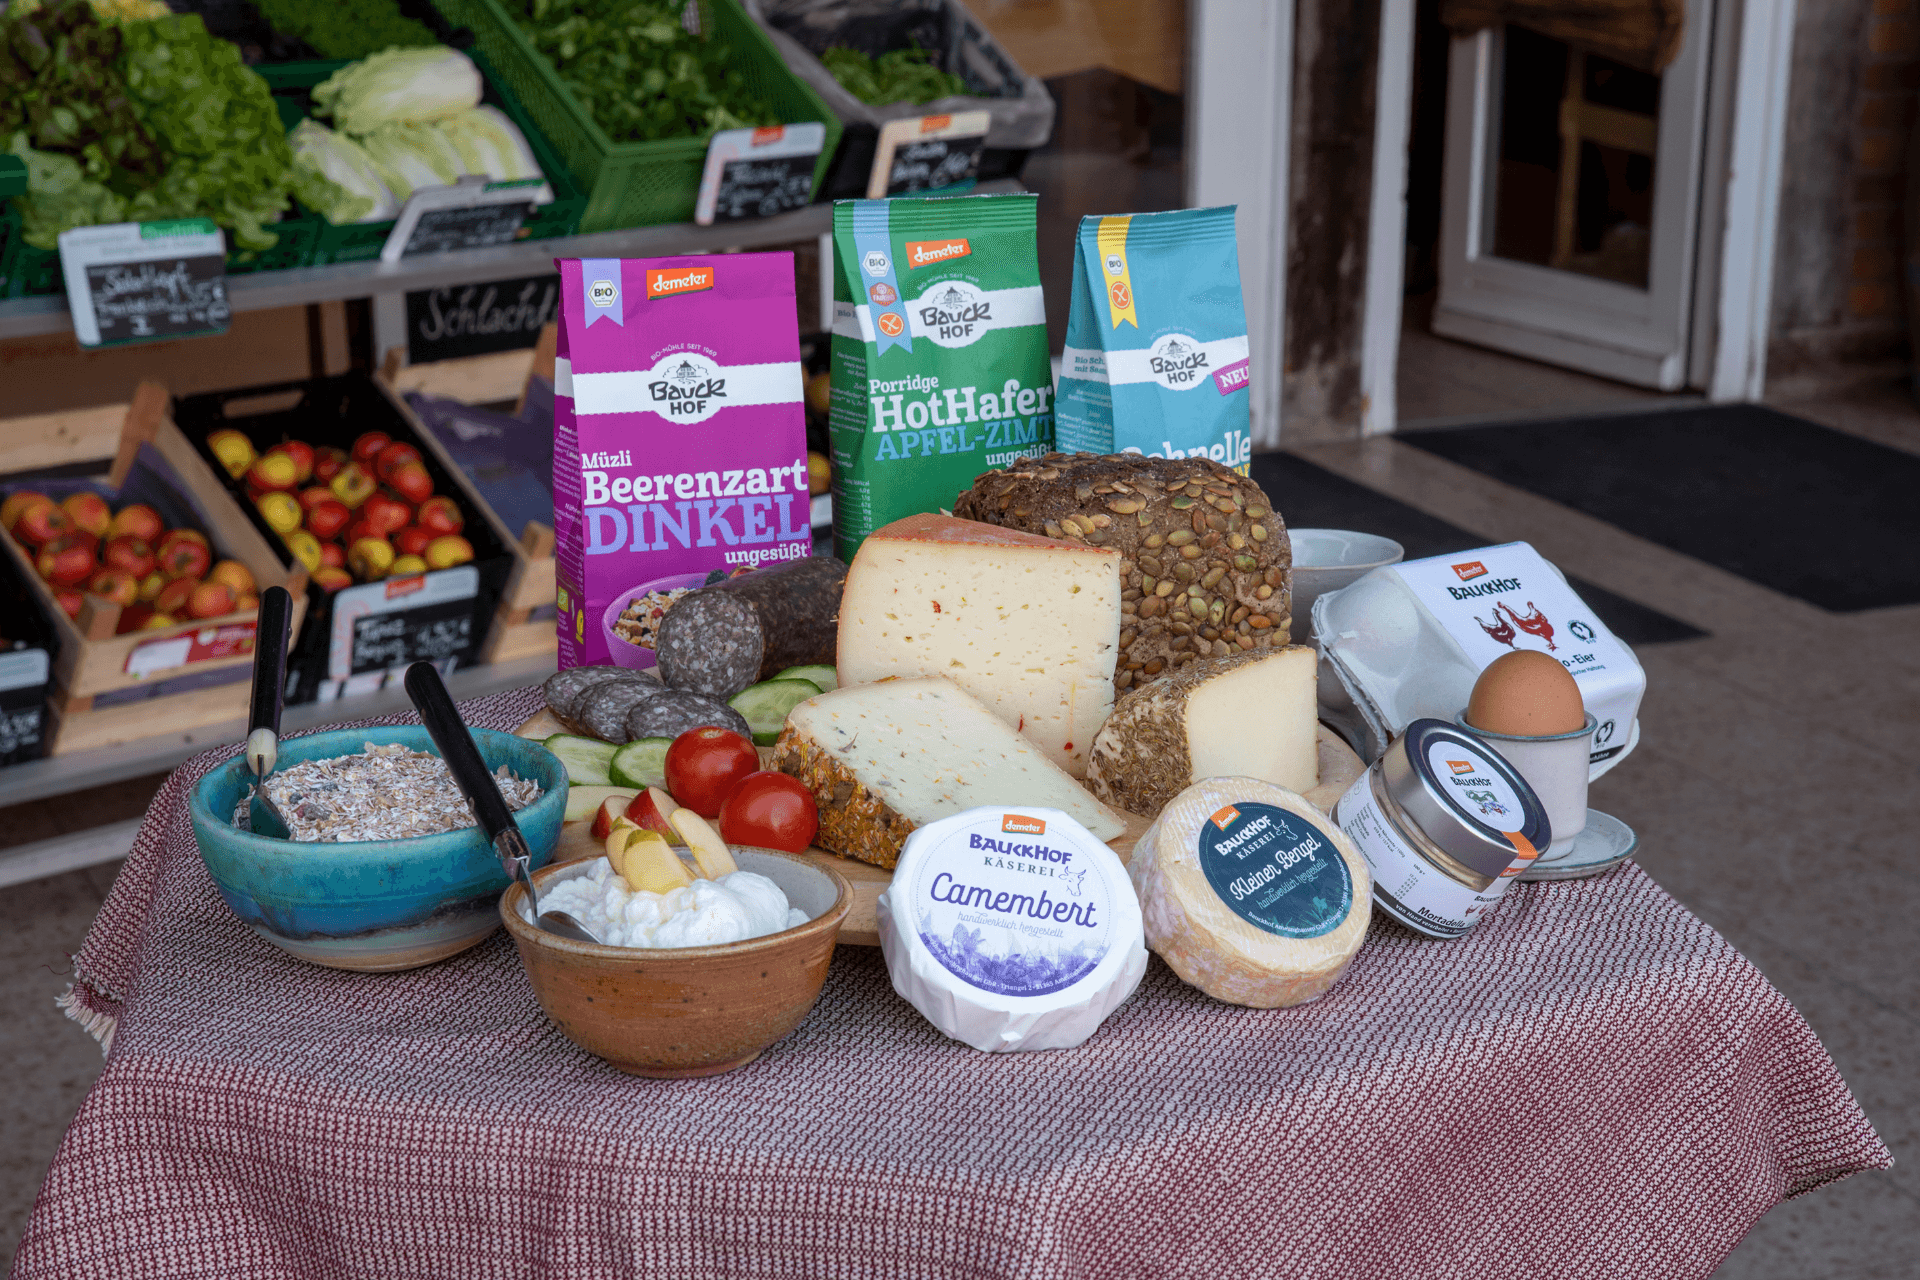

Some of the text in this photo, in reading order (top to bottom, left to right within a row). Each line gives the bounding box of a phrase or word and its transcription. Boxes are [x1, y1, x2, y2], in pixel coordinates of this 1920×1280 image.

[868, 258, 886, 267] BIO
[913, 244, 964, 262] demeter
[594, 287, 613, 297] BIO
[653, 273, 707, 292] demeter
[939, 324, 974, 339] HOF
[650, 342, 718, 361] BIO-MÜHLE SEIT 1969
[1075, 356, 1105, 365] Bio Sch
[868, 374, 939, 395] Porridge
[1167, 370, 1196, 384] HOF
[1220, 365, 1250, 387] NEU
[670, 400, 707, 415] HOF
[870, 379, 1053, 433] HotHafer
[874, 414, 1053, 461] APFEL-ZIMT
[1121, 430, 1250, 467] hnelle
[581, 450, 632, 469] Müzli
[582, 459, 808, 505] Beerenzart
[584, 494, 810, 555] DINKEL
[1561, 653, 1596, 667] o-Eier
[1005, 819, 1041, 833] demeter
[1236, 831, 1276, 861] KÄSEREI
[983, 855, 1056, 878] KÄSEREI
[1229, 832, 1322, 901] Kleiner Bengel
[1256, 857, 1329, 910] handwerklich hergestellt
[930, 872, 1098, 928] Camembert
[1248, 911, 1274, 927] Bauckhof
[1395, 904, 1406, 914] von
[1406, 910, 1423, 923] Hand
[1417, 906, 1466, 928] Mortadella
[957, 910, 1064, 939] handwerklich hergestellt
[1000, 983, 1027, 992] Triangel
